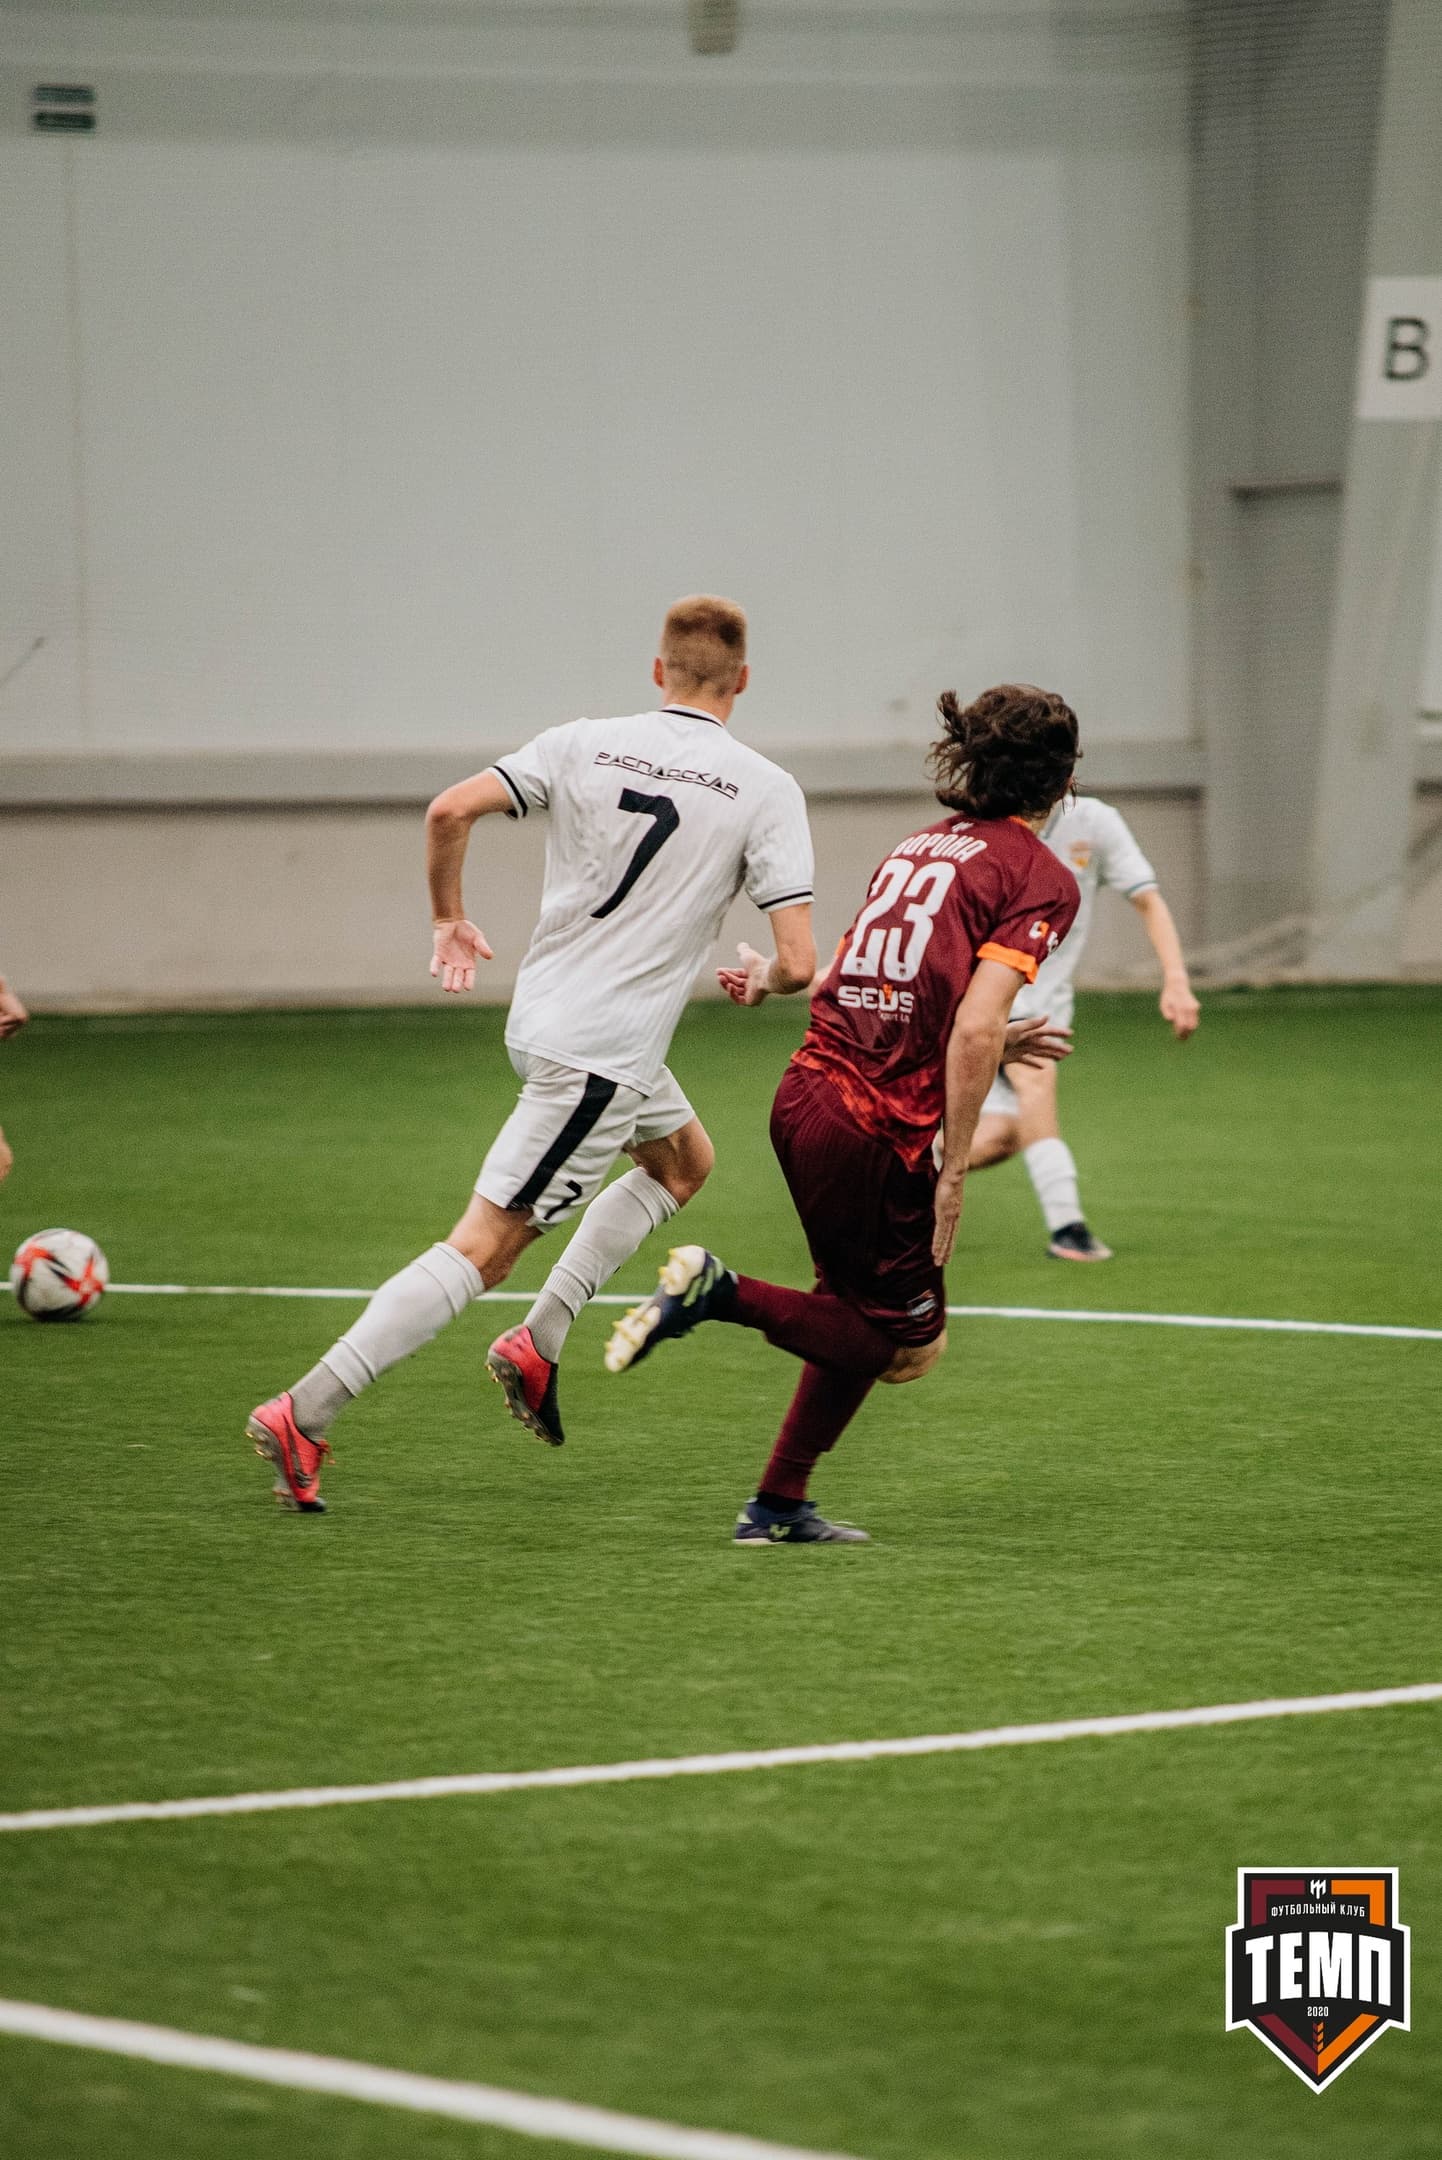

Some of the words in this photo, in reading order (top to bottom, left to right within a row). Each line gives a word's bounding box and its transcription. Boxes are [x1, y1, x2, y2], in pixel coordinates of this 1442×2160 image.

[590, 787, 680, 919] 7
[839, 857, 956, 982] 23
[837, 984, 915, 1014] SEUS
[544, 1180, 582, 1221] 7
